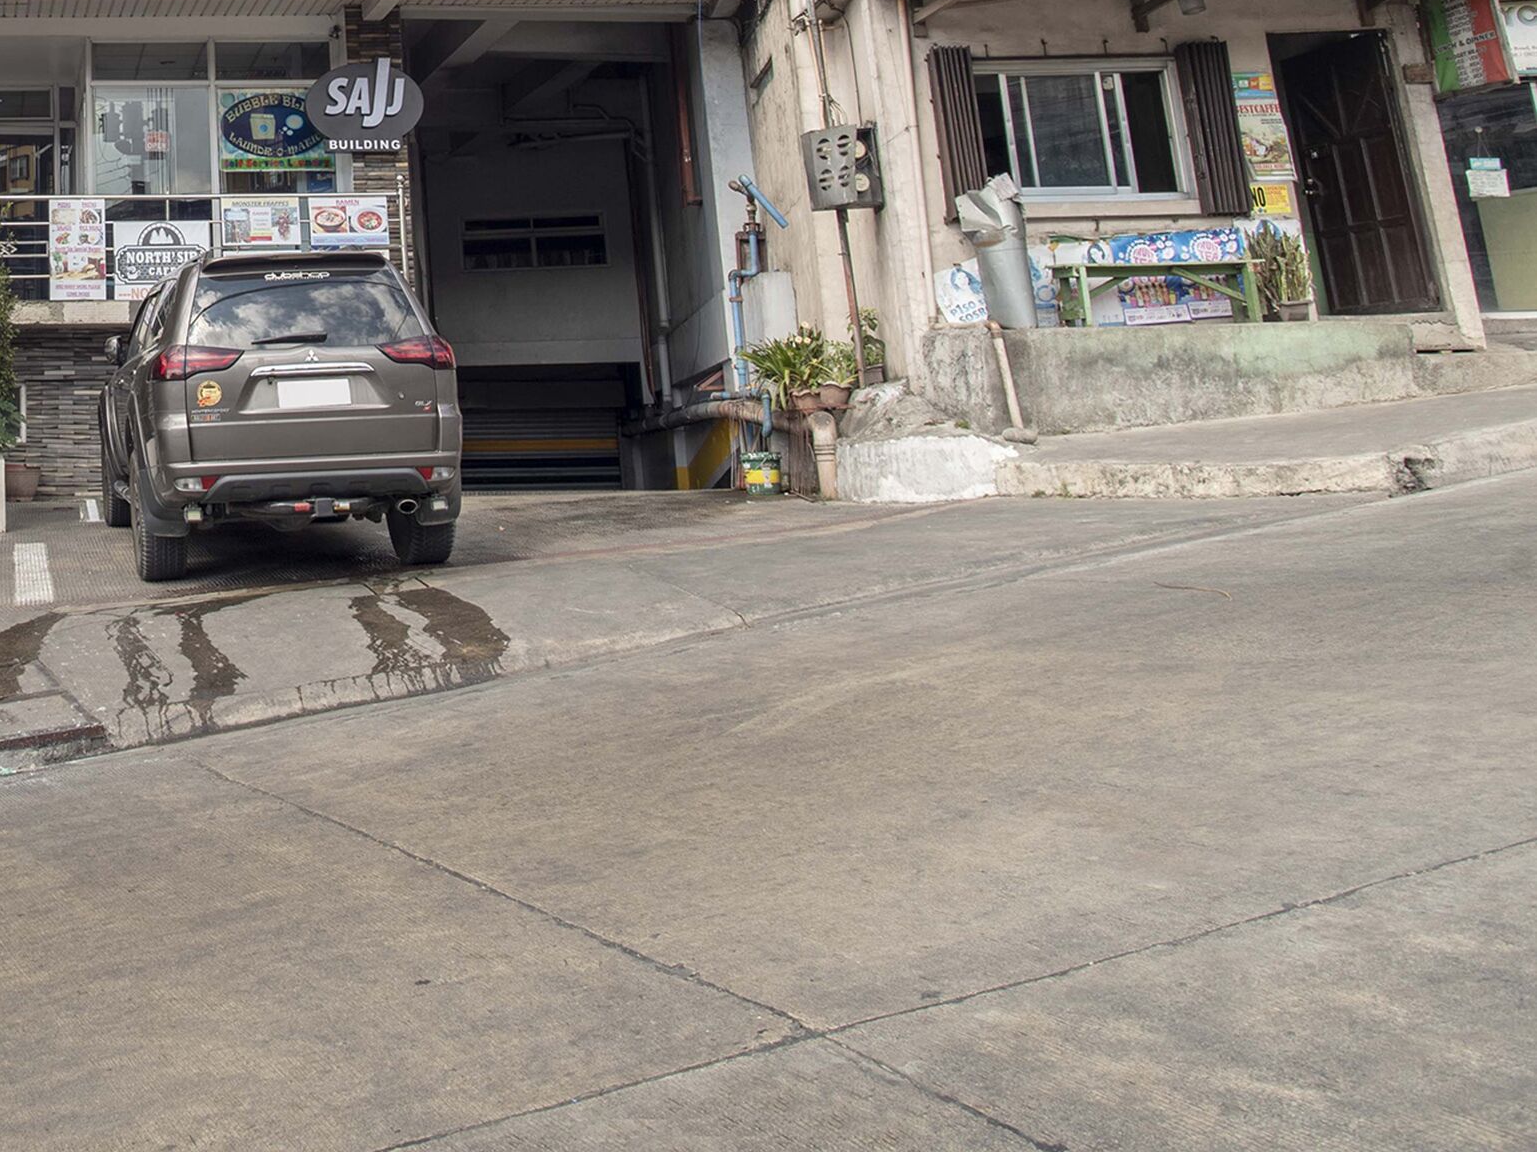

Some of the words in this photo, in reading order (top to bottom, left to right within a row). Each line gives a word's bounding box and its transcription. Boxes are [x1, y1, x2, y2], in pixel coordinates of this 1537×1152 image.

[1458, 39, 1466, 47] &
[324, 57, 405, 127] SAJJ
[224, 94, 280, 123] BUBBLE
[328, 139, 402, 150] BUILDING
